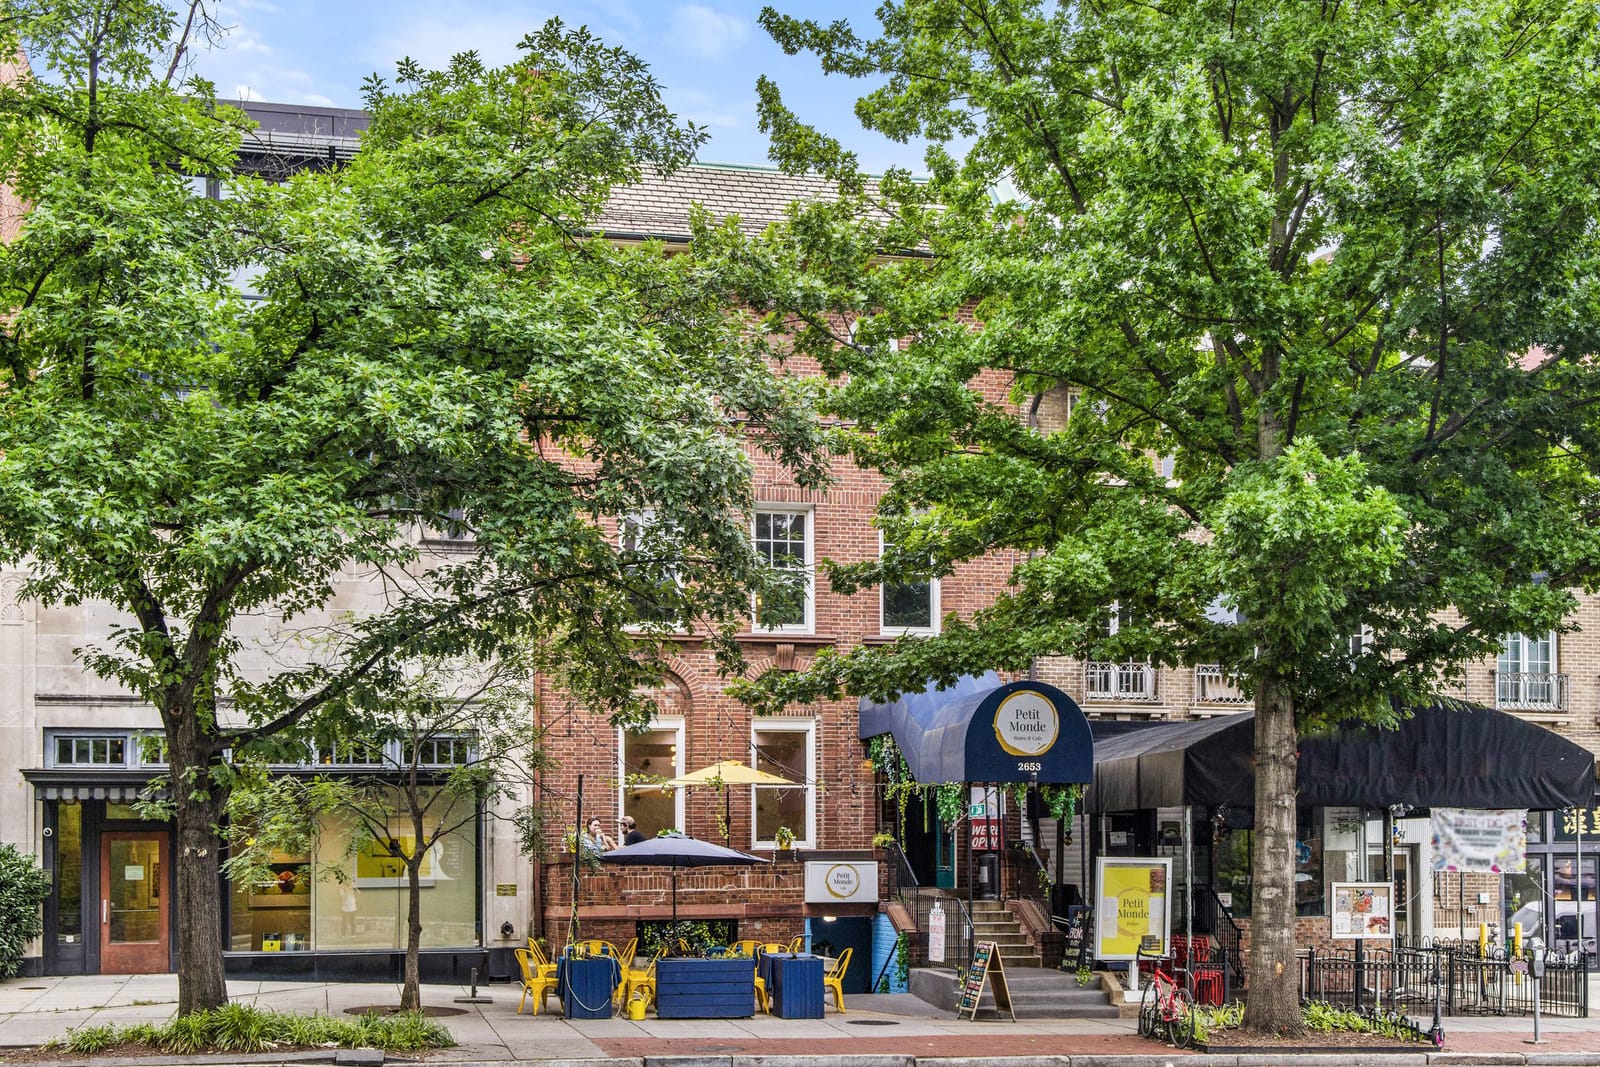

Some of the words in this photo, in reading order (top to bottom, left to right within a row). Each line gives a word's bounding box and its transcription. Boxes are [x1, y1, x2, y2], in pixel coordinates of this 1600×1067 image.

[1015, 708, 1040, 720] Petit
[1009, 720, 1047, 732] Monde
[1017, 762, 1041, 771] 2653
[1123, 898, 1144, 908] Petit
[1118, 908, 1149, 918] Monde
